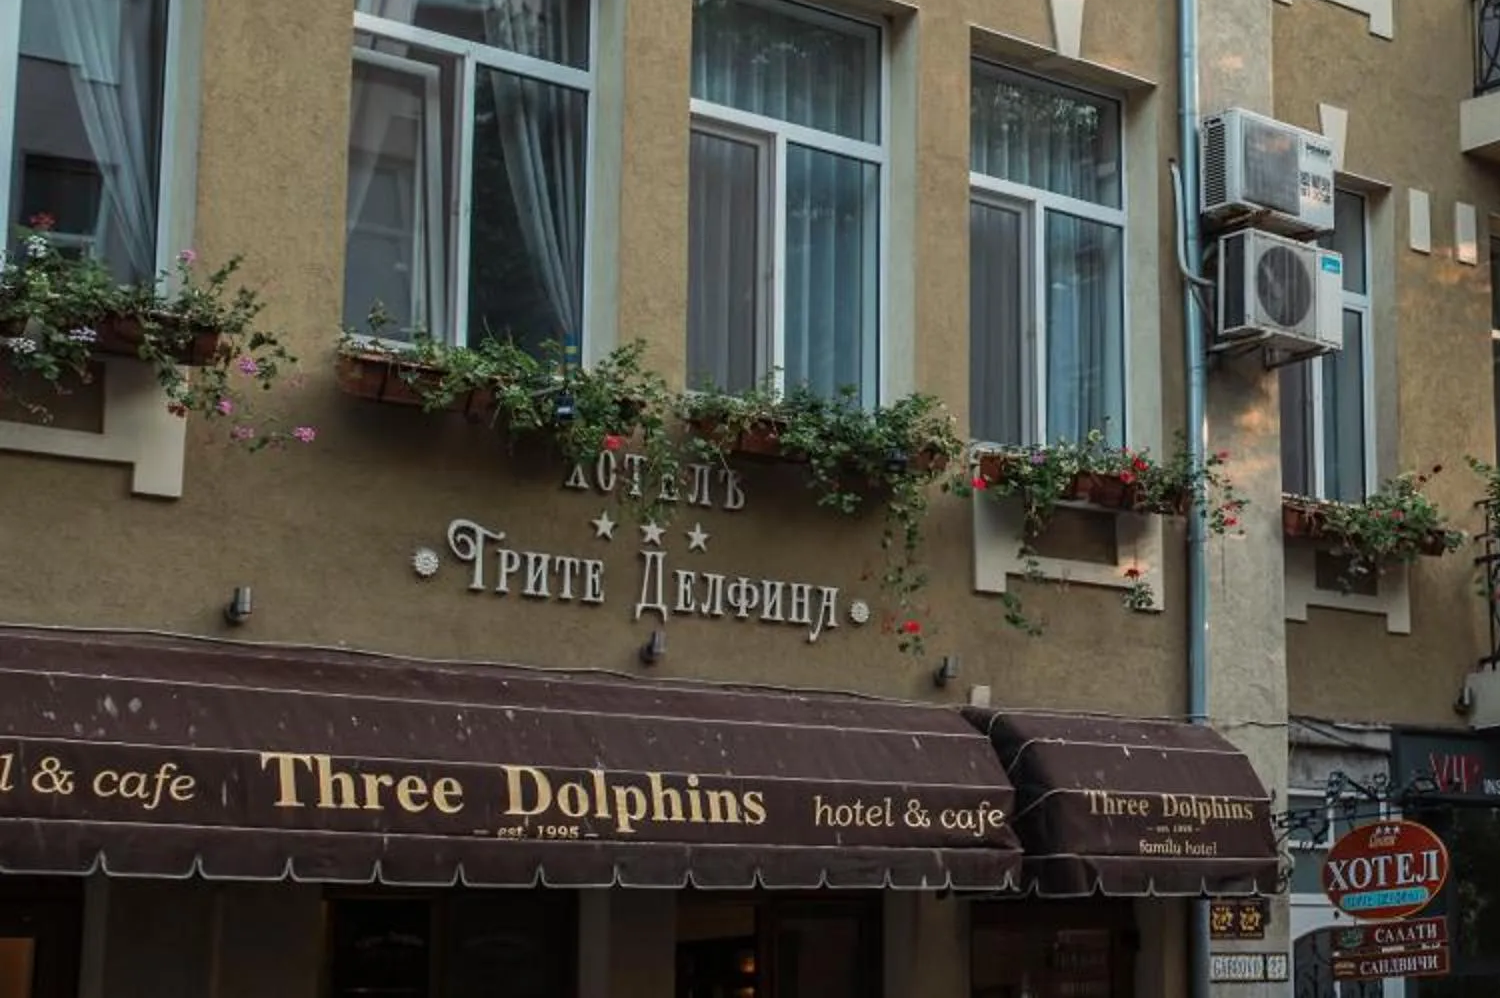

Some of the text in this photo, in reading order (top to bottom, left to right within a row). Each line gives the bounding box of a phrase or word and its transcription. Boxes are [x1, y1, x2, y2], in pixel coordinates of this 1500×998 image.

[32, 757, 75, 795] &
[93, 762, 197, 810] cafe
[261, 752, 767, 833] Three Dolphins
[814, 795, 1006, 837] hotel & cafe
[1084, 790, 1254, 825] Three Dolphins
[536, 825, 580, 839] 1995
[1139, 836, 1218, 856] family hotel
[1327, 849, 1441, 891] ХОТЕЛ
[1374, 923, 1438, 943] САЛАТИ
[1359, 955, 1439, 976] САНДВИЧИ
